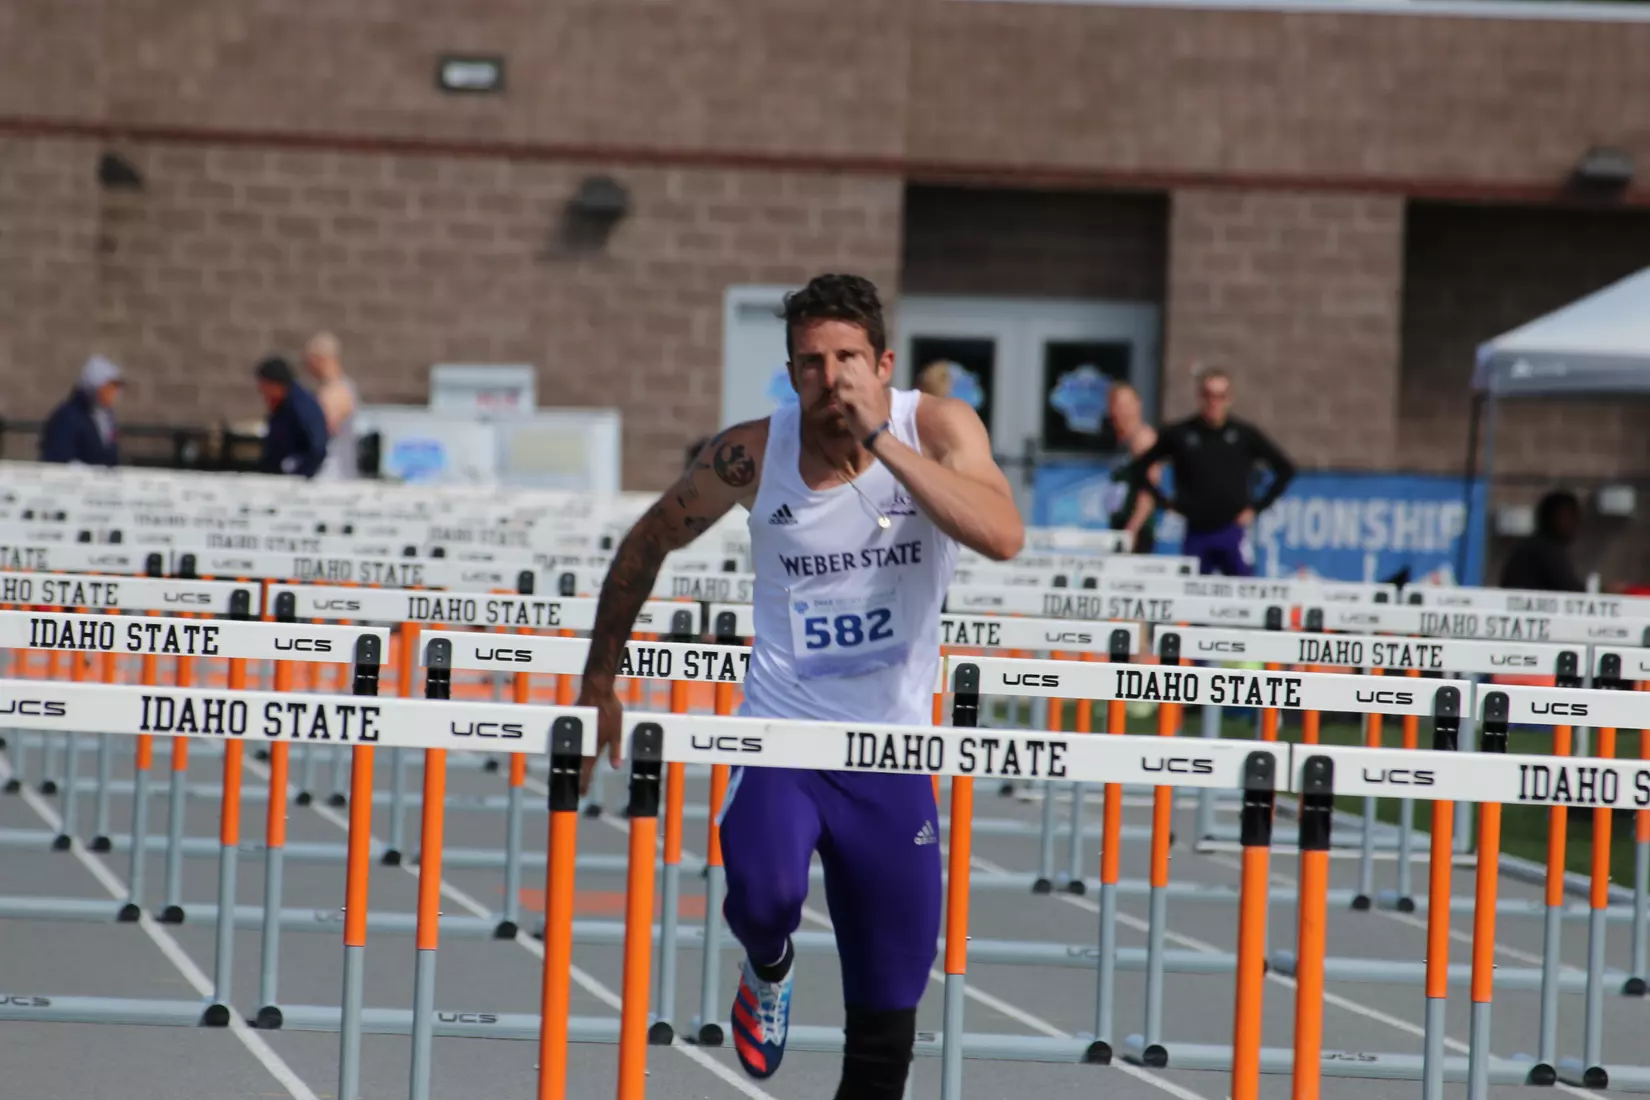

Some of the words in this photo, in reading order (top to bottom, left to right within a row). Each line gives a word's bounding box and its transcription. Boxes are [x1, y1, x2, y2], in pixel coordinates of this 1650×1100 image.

[0, 546, 48, 570] TATE
[779, 552, 856, 577] WEBER
[860, 540, 922, 568] STATE
[293, 557, 352, 581] IDAHO
[360, 562, 424, 585] STATE
[42, 580, 119, 606] STATE
[164, 591, 211, 604] UCS
[672, 576, 729, 600] IDAHO
[313, 600, 361, 611] UCS
[408, 596, 476, 622] IDAHO
[486, 600, 561, 626] STATE
[1043, 593, 1101, 618] IDAHO
[1109, 597, 1173, 621] STATE
[30, 618, 114, 650] IDAHO
[127, 623, 219, 655] STATE
[804, 607, 893, 649] 582
[941, 620, 1001, 646] TATE
[1045, 632, 1092, 643] UCS
[1419, 612, 1478, 636] IDAHO
[1486, 615, 1550, 640] STATE
[275, 637, 332, 652] UCS
[475, 647, 532, 662] UCS
[1198, 641, 1246, 652] UCS
[1298, 639, 1363, 666] IDAHO
[1372, 643, 1443, 668] STATE
[619, 648, 672, 678] AHO
[684, 651, 752, 682] STAT
[1490, 655, 1538, 666] UCS
[1002, 673, 1059, 688] UCS
[1116, 670, 1199, 702] IDAHO
[1210, 675, 1301, 707] STATE
[1356, 689, 1413, 705] UCS
[1531, 702, 1588, 716] UCS
[140, 696, 247, 735] IDAHO
[264, 702, 380, 741] STATE
[451, 721, 523, 738] UCS
[692, 735, 763, 752] UCS
[845, 731, 944, 772] IDAHO
[959, 738, 1067, 777] STATE
[1141, 756, 1213, 773] UCS
[1363, 768, 1435, 785] UCS
[1519, 765, 1618, 804] IDAHO
[438, 1011, 498, 1024] UCS
